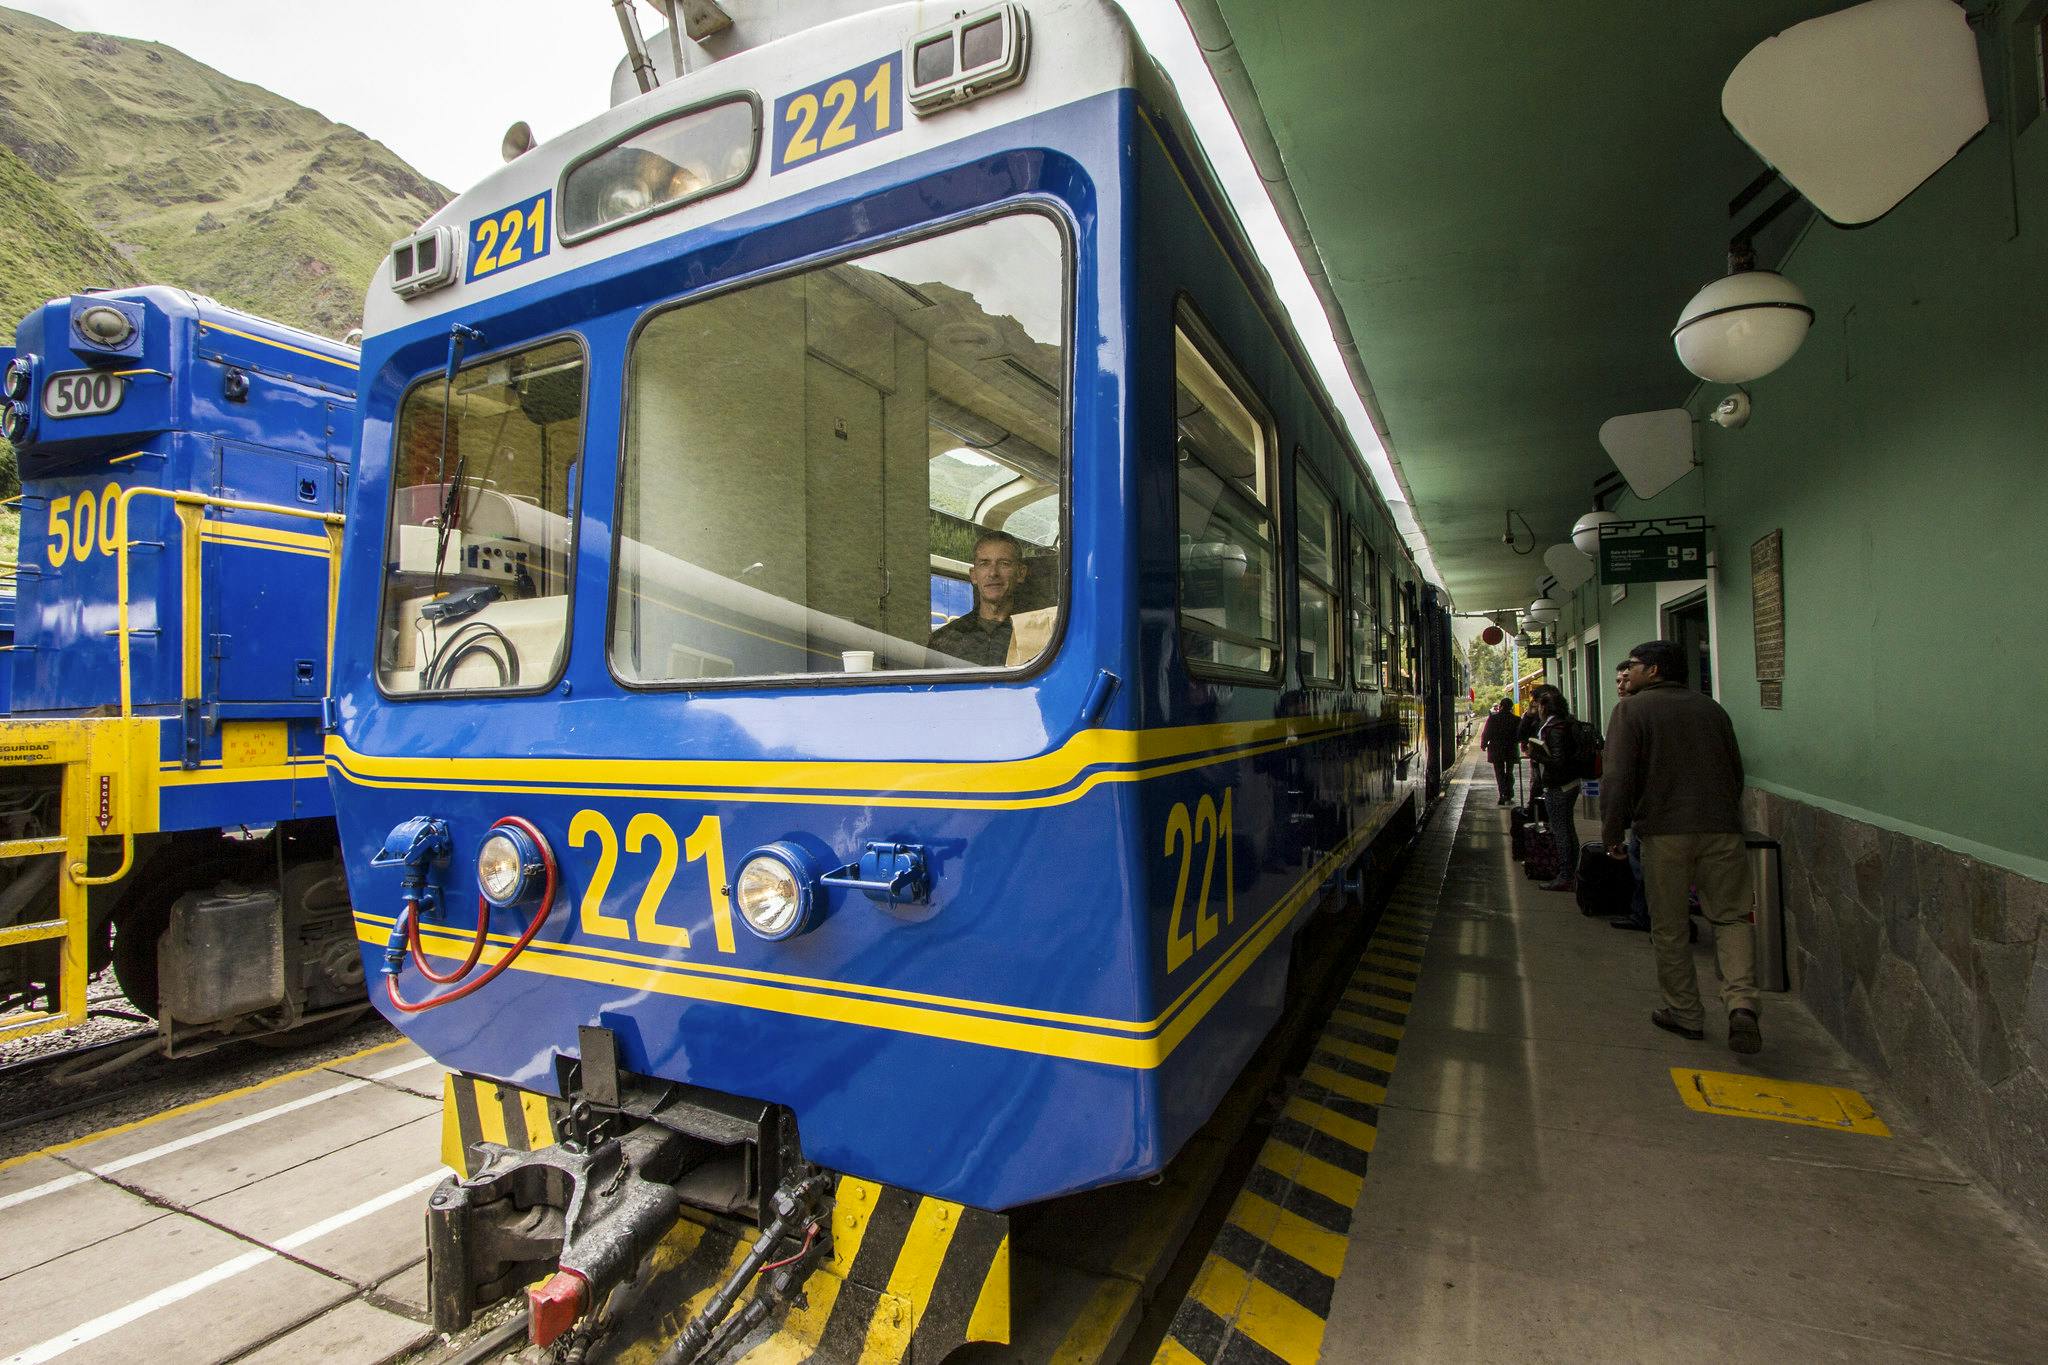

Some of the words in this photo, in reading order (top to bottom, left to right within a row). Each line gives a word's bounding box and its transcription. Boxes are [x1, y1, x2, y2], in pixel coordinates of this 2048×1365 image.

[783, 62, 892, 165] 221
[473, 198, 546, 277] 221
[56, 374, 111, 413] 500
[47, 481, 123, 568] 500
[568, 809, 736, 954] 221
[1164, 786, 1234, 975] 221
